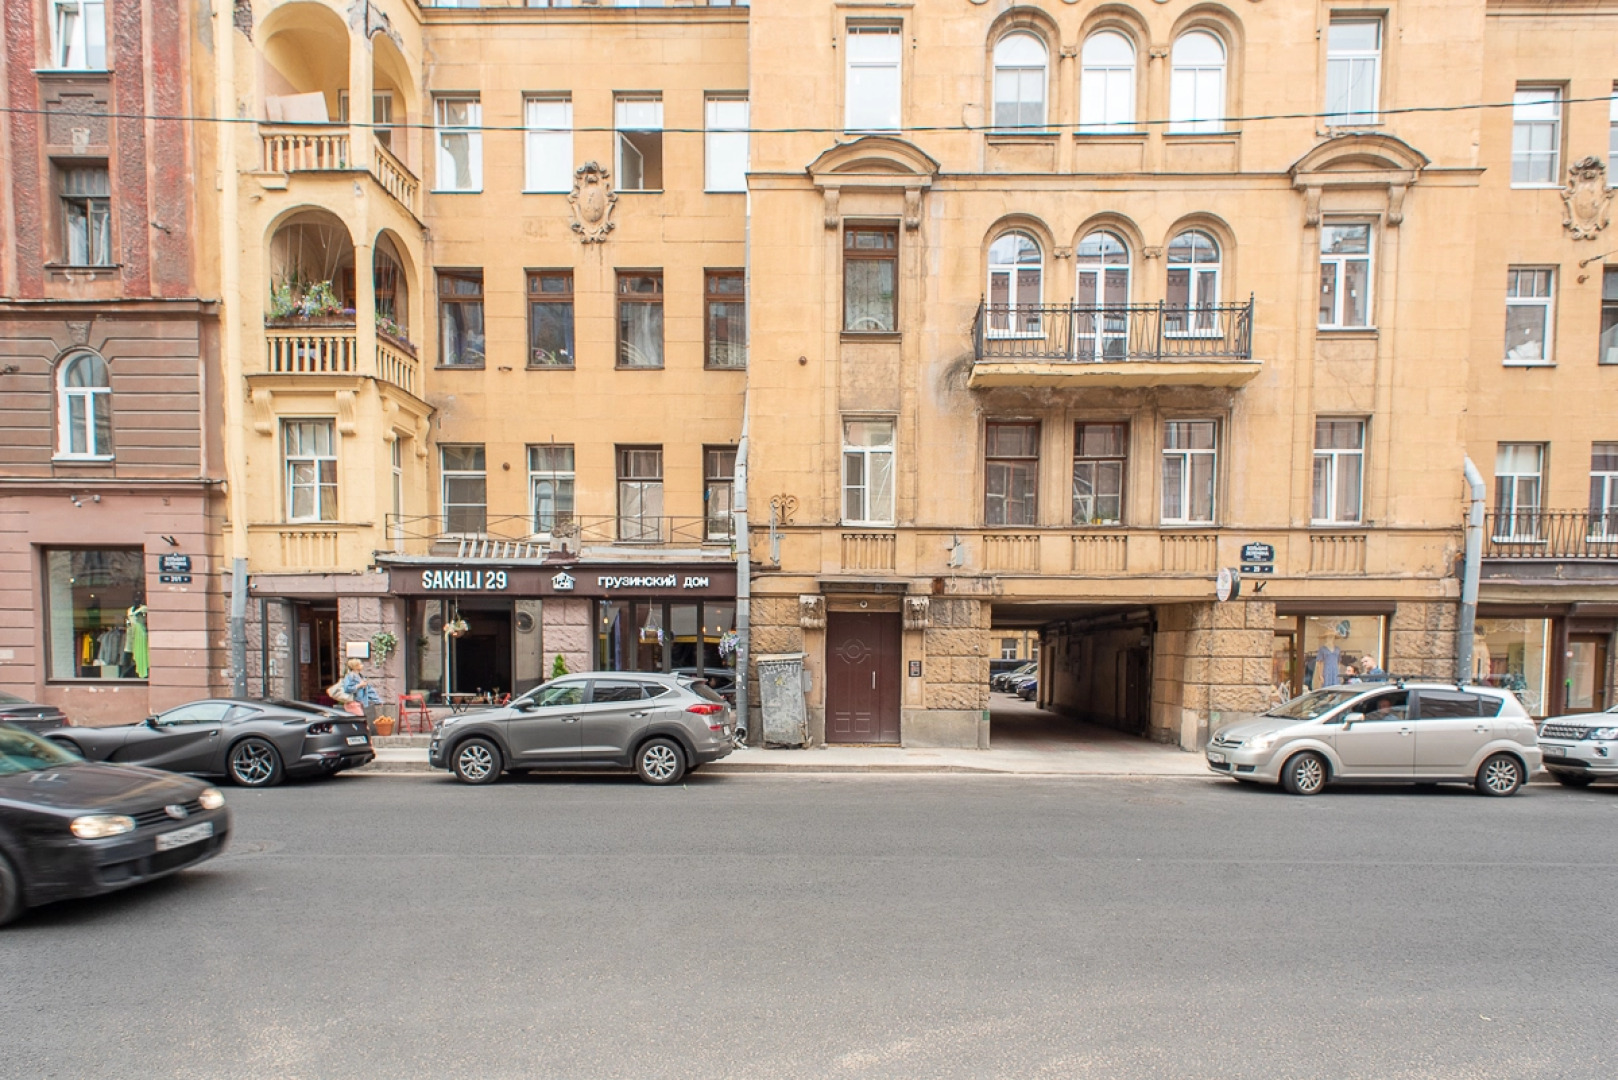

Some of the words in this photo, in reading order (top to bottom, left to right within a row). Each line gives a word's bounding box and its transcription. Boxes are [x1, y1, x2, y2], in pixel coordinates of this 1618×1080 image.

[422, 570, 482, 590] SAKHLI
[485, 570, 507, 590] 29
[598, 574, 676, 589] грузинский
[683, 576, 709, 588] дом
